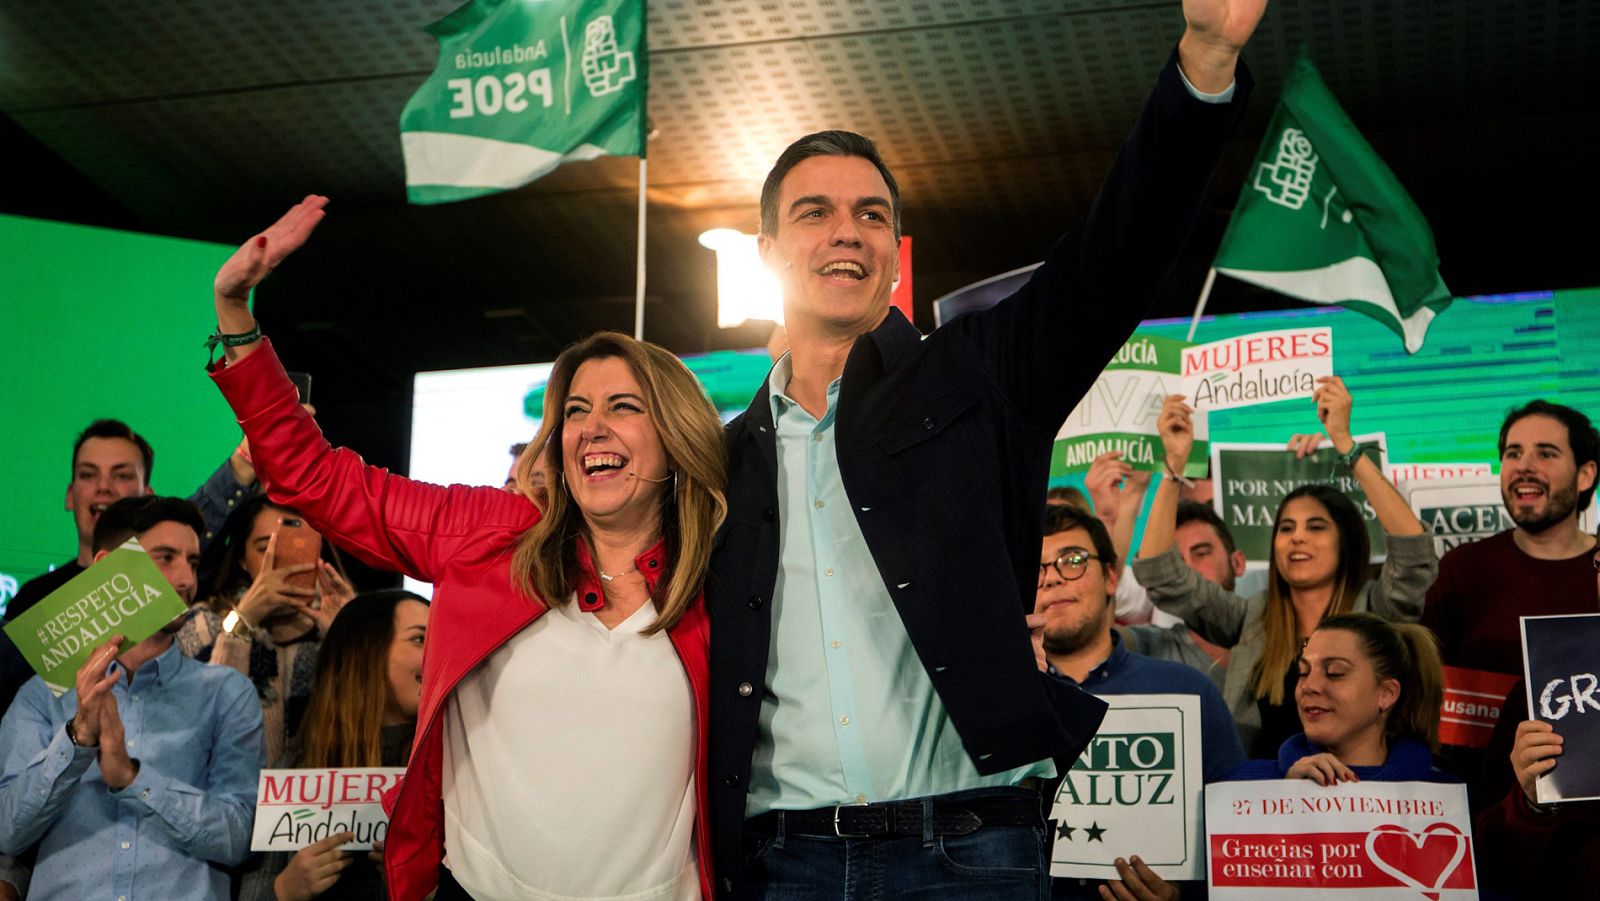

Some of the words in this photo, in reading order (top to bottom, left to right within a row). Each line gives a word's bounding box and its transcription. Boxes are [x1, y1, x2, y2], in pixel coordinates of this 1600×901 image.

[1111, 338, 1158, 365] UCÍA
[1183, 332, 1330, 377] MUJERES
[1194, 369, 1315, 408] Andalucía
[1228, 479, 1269, 496] POR
[37, 573, 131, 646] #RESPETO
[40, 583, 163, 672] ANDALUCÍA
[1539, 672, 1600, 720] GR
[1054, 773, 1174, 806] ALUZ
[1232, 800, 1251, 816] 27
[1261, 799, 1294, 816] DE
[1301, 797, 1444, 817] NOVIEMBRE
[1222, 838, 1313, 859] Gracias
[1320, 843, 1360, 864] por
[1222, 858, 1315, 879] enseñar
[1322, 862, 1364, 879] con
